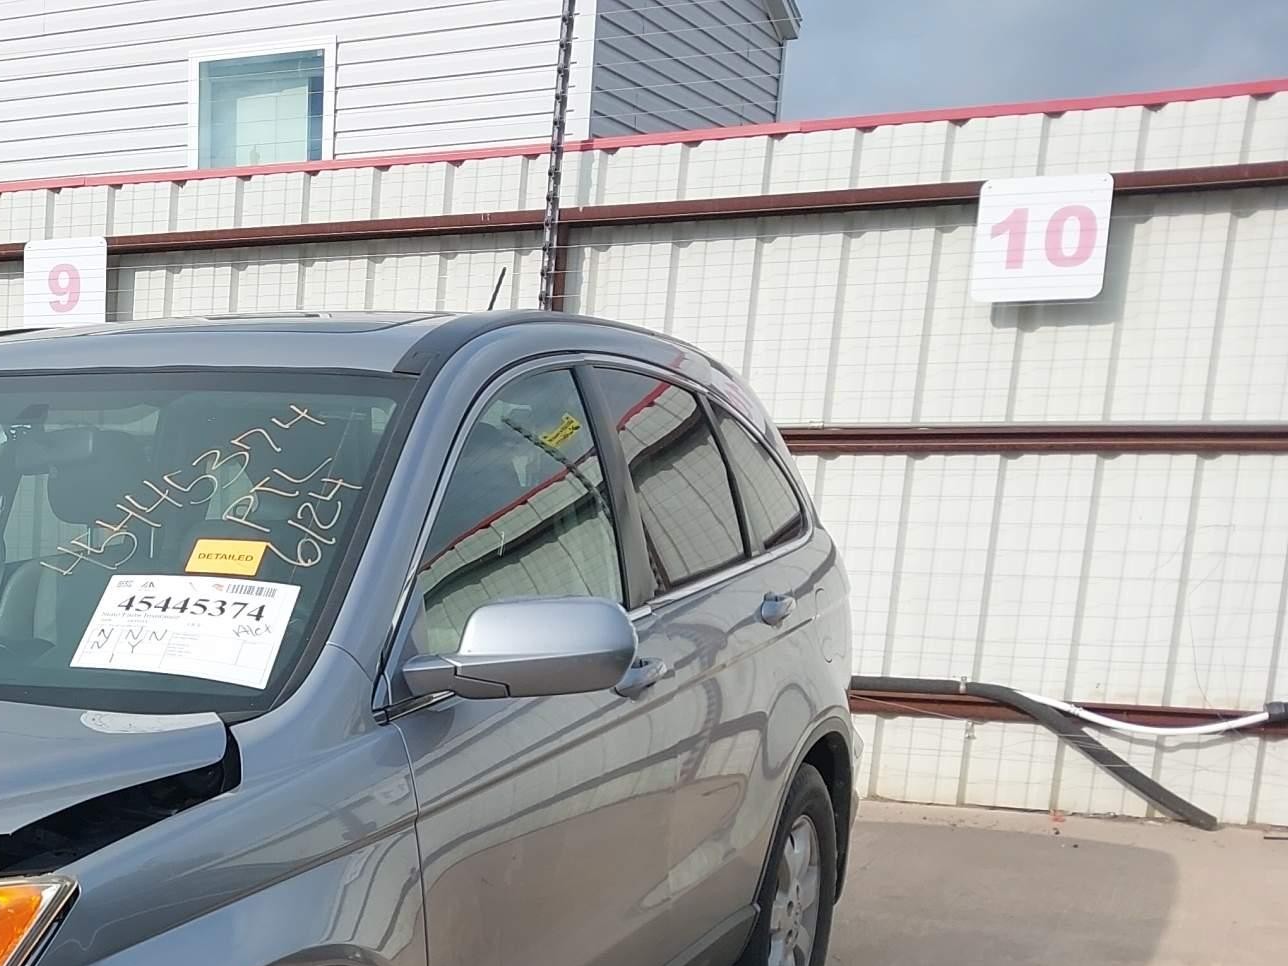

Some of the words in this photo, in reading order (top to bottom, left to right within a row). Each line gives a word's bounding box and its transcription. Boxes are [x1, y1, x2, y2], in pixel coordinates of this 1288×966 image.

[990, 204, 1098, 270] 10
[48, 263, 81, 313] 9
[39, 403, 326, 577] 45445374
[197, 552, 254, 562] DETAILED
[117, 594, 266, 622] 45445374
